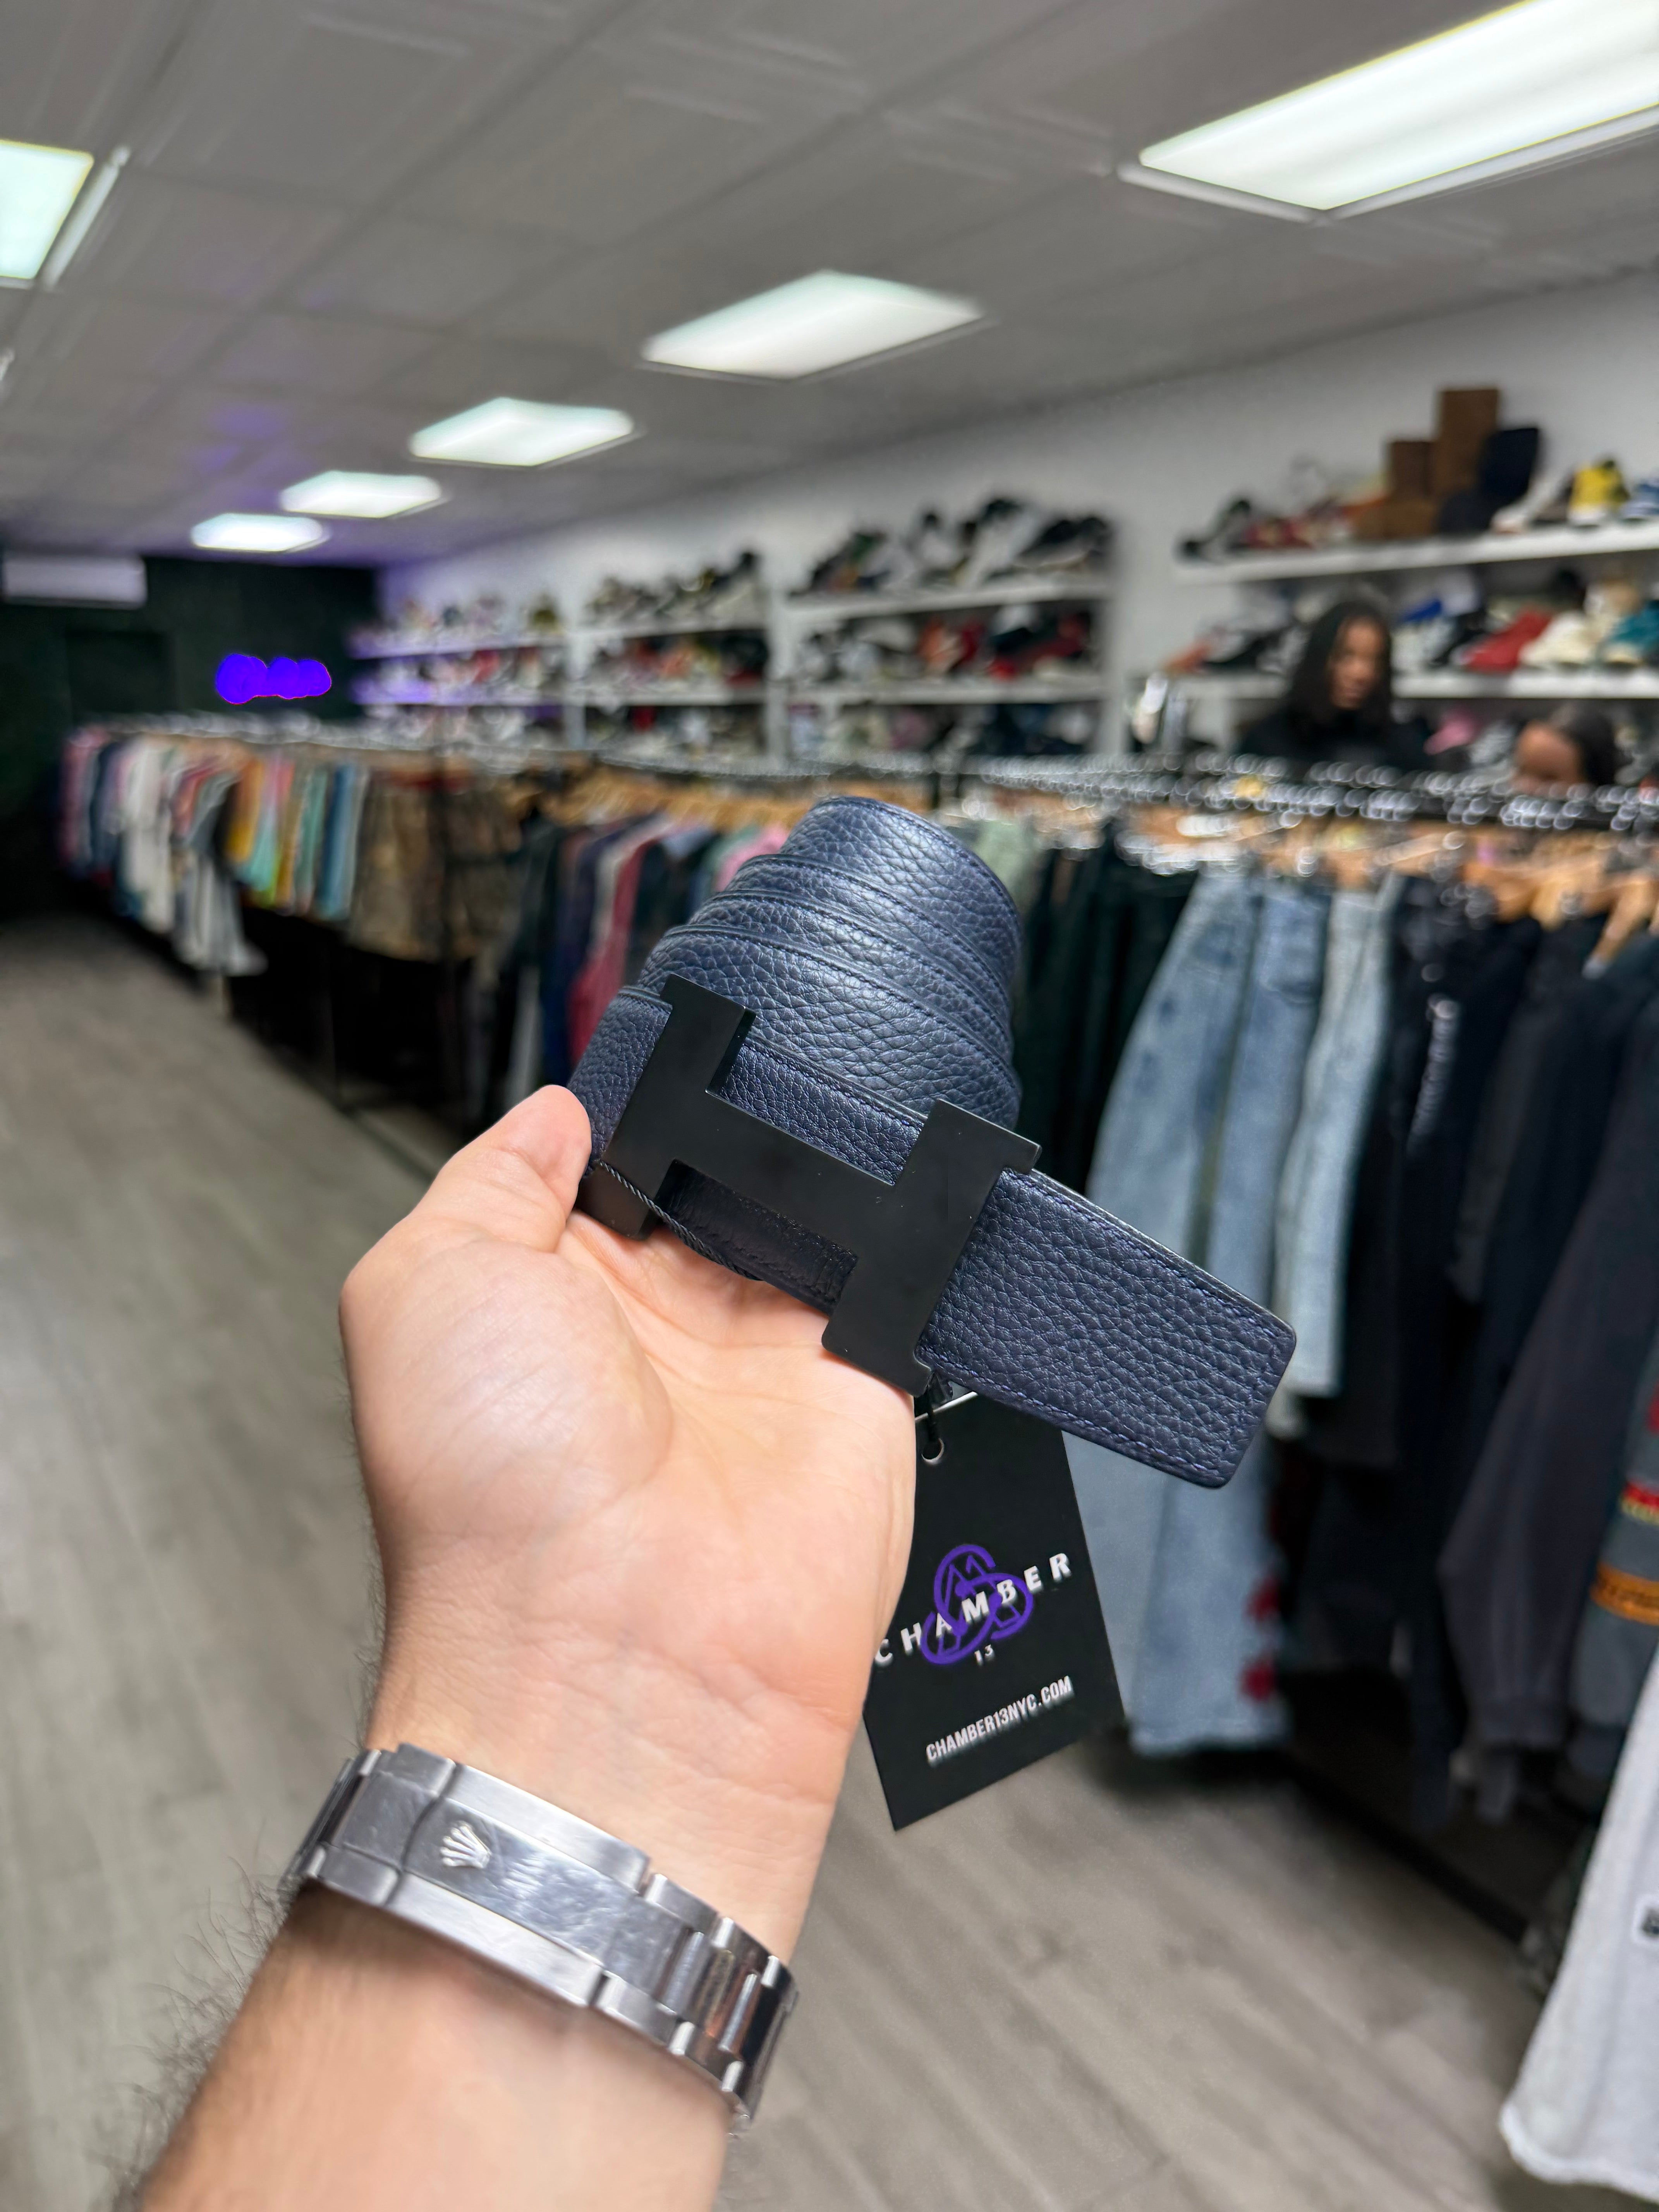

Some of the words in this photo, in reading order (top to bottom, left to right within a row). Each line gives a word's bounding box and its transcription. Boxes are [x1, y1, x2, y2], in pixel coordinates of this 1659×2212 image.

[874, 1553, 1072, 1664] CHAMBER
[974, 1644, 994, 1664] 13
[926, 1675, 1073, 1762] CHAMBER13NYC.COM
